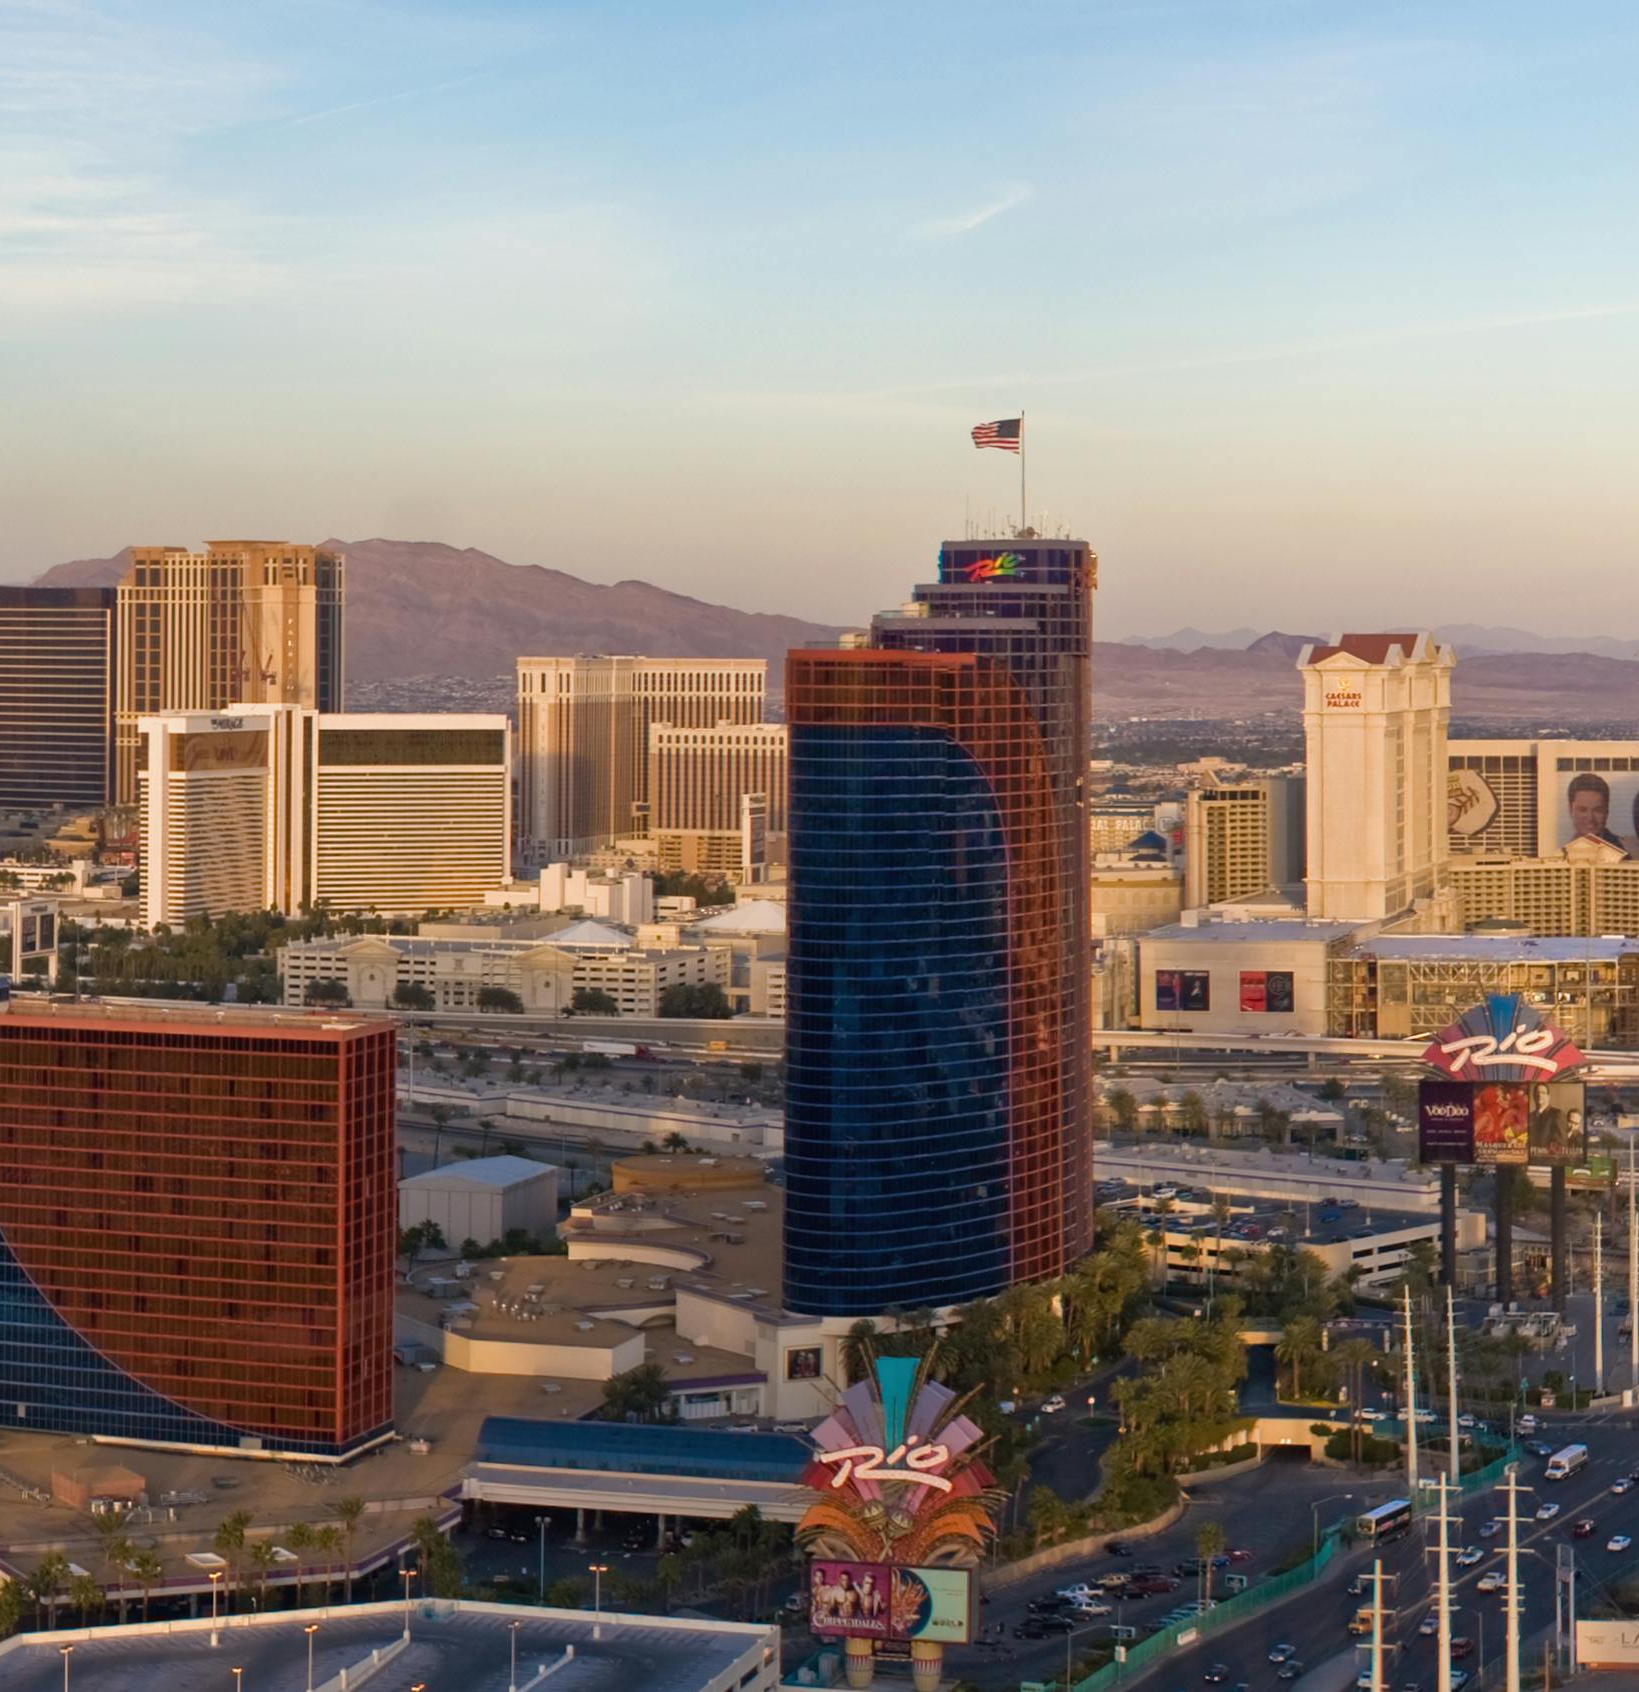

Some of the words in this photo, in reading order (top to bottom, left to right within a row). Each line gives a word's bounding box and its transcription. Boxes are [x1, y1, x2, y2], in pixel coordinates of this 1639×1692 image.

[963, 551, 1026, 583] Rio
[1325, 692, 1362, 700] CAESARS
[1326, 700, 1360, 708] PALACE
[1440, 1023, 1558, 1073] Rio
[1530, 1146, 1548, 1155] PENN
[1561, 1146, 1583, 1155] TELLER
[819, 1434, 954, 1494] Rio
